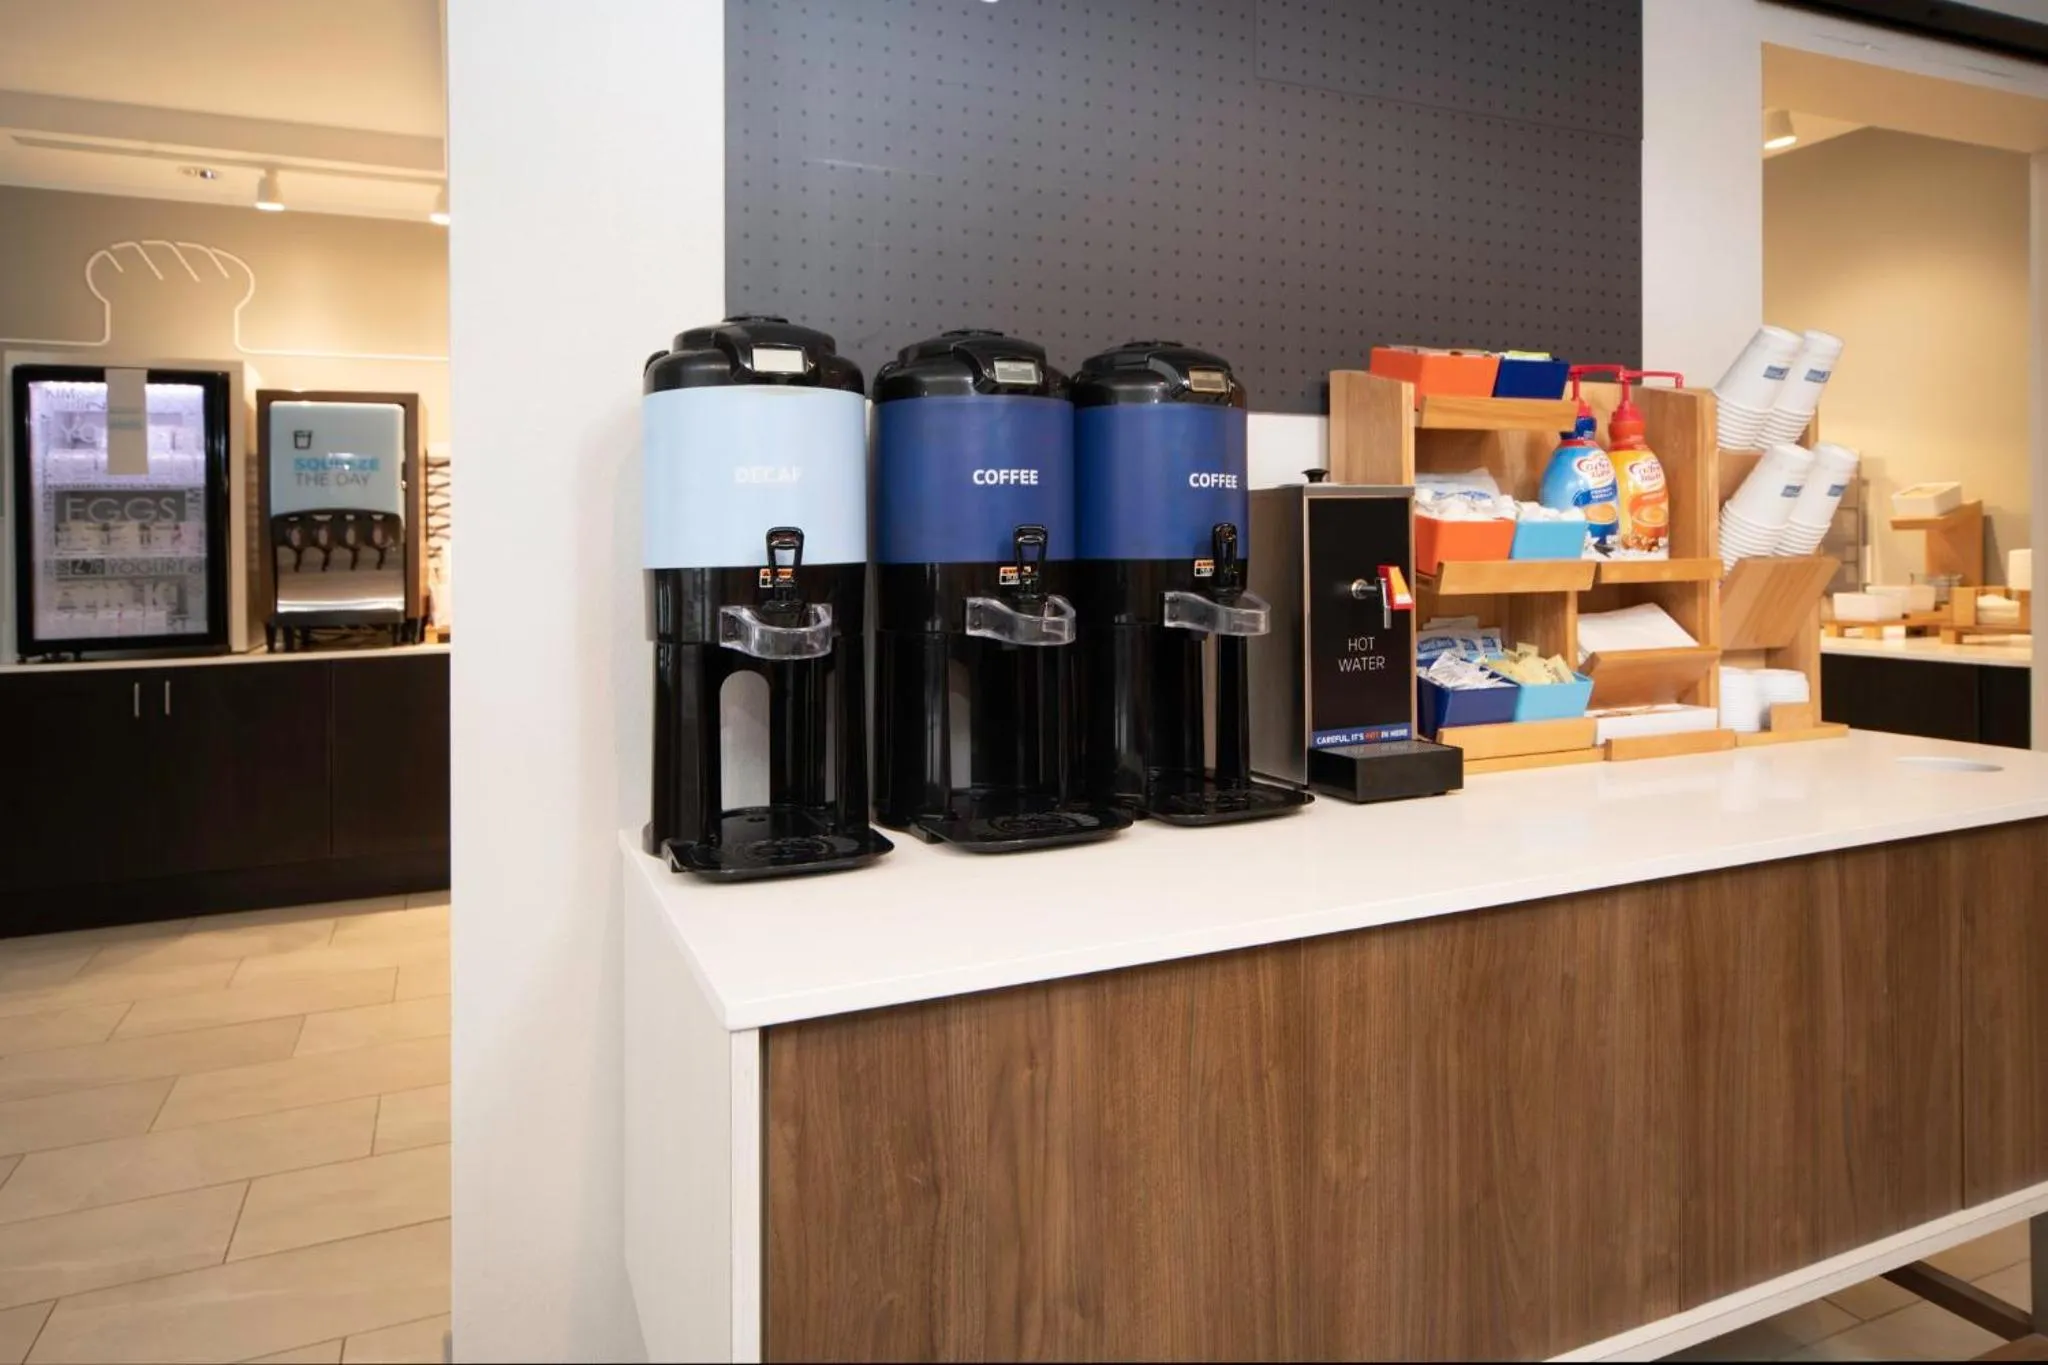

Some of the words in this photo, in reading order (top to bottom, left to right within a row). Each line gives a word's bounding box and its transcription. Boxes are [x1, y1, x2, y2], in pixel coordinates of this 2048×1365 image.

[295, 472, 329, 487] THE
[336, 472, 371, 487] DAY
[973, 469, 1039, 485] COFFEE
[1189, 473, 1238, 489] COFFEE
[65, 496, 177, 523] EGGS
[1348, 636, 1375, 652] HOT
[1337, 655, 1386, 673] WATER
